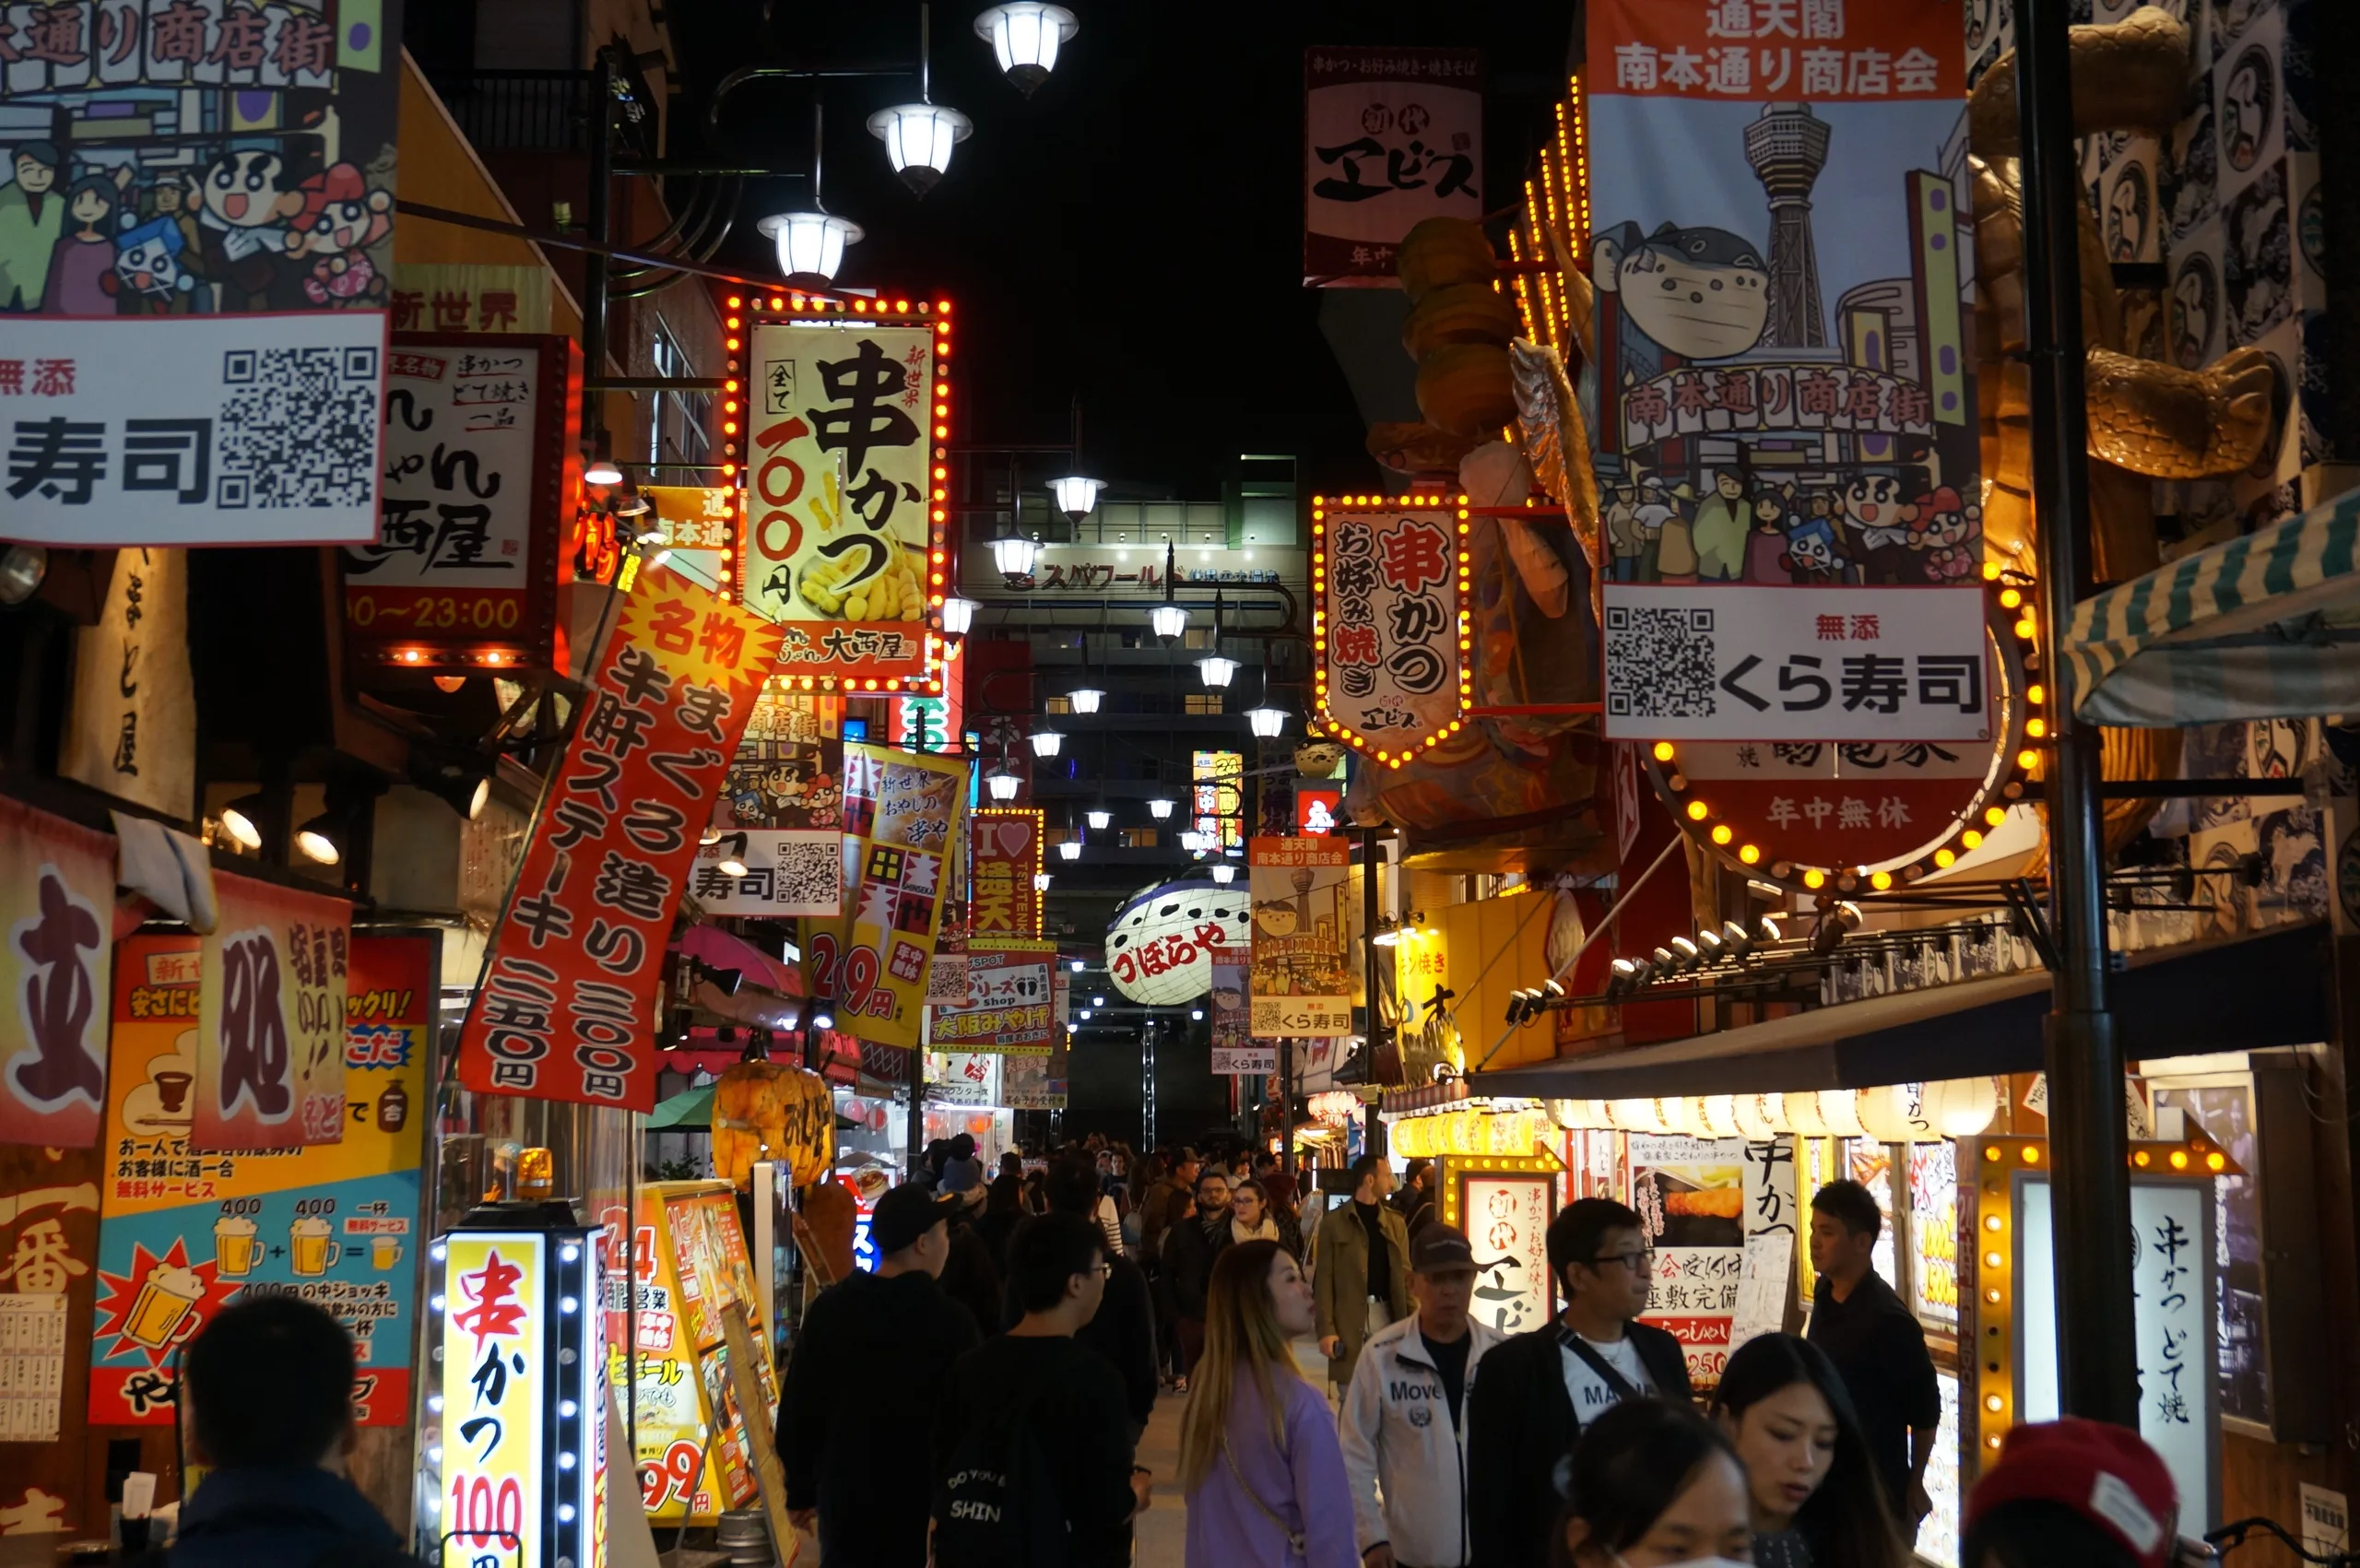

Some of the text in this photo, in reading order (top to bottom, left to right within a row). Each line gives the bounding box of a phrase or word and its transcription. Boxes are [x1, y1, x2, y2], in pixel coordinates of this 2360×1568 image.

[1705, 0, 1844, 40] 通天閣
[0, 5, 335, 76] 通り商店街
[1615, 41, 1938, 95] 南本通り商店会
[457, 356, 524, 375] 串かつ
[903, 344, 926, 407] 新世界
[452, 381, 530, 404] どて焼き
[1628, 371, 1930, 428] 南本通り商店街
[388, 389, 432, 431] ん
[468, 409, 516, 430] 一品
[388, 442, 500, 500] ゃん
[805, 338, 922, 591] 串かつ
[1333, 522, 1382, 697] お好み焼き
[1380, 520, 1451, 693] 串かつ
[649, 598, 749, 674] 名物
[1815, 613, 1882, 642] 無添
[819, 629, 914, 663] 大西屋
[1718, 653, 1982, 714] くら寿司
[881, 771, 932, 795] 新世界
[1766, 796, 1913, 830] 年中無休
[907, 819, 949, 845] 串や
[977, 822, 998, 857] I
[1257, 852, 1343, 866] 南本通り商店会
[1113, 920, 1226, 984] づぼらや
[1398, 950, 1445, 975] ン焼き
[811, 933, 895, 1020] 29円
[984, 996, 1016, 1007] Shop
[933, 1007, 1051, 1041] 大阪みやげ
[1281, 1014, 1350, 1030] くら寿司
[1231, 1060, 1275, 1070] くら寿司
[940, 1087, 989, 1098] ウンター席
[117, 1159, 235, 1179] お客様に酒一合
[114, 1180, 218, 1199] 無料サービス
[220, 1198, 390, 1215] 400 400 一杯
[1650, 1252, 1742, 1281] 会受付中
[452, 1250, 526, 1463] 串かつ
[452, 1474, 523, 1551] 100
[950, 1499, 1001, 1523] SHIN
